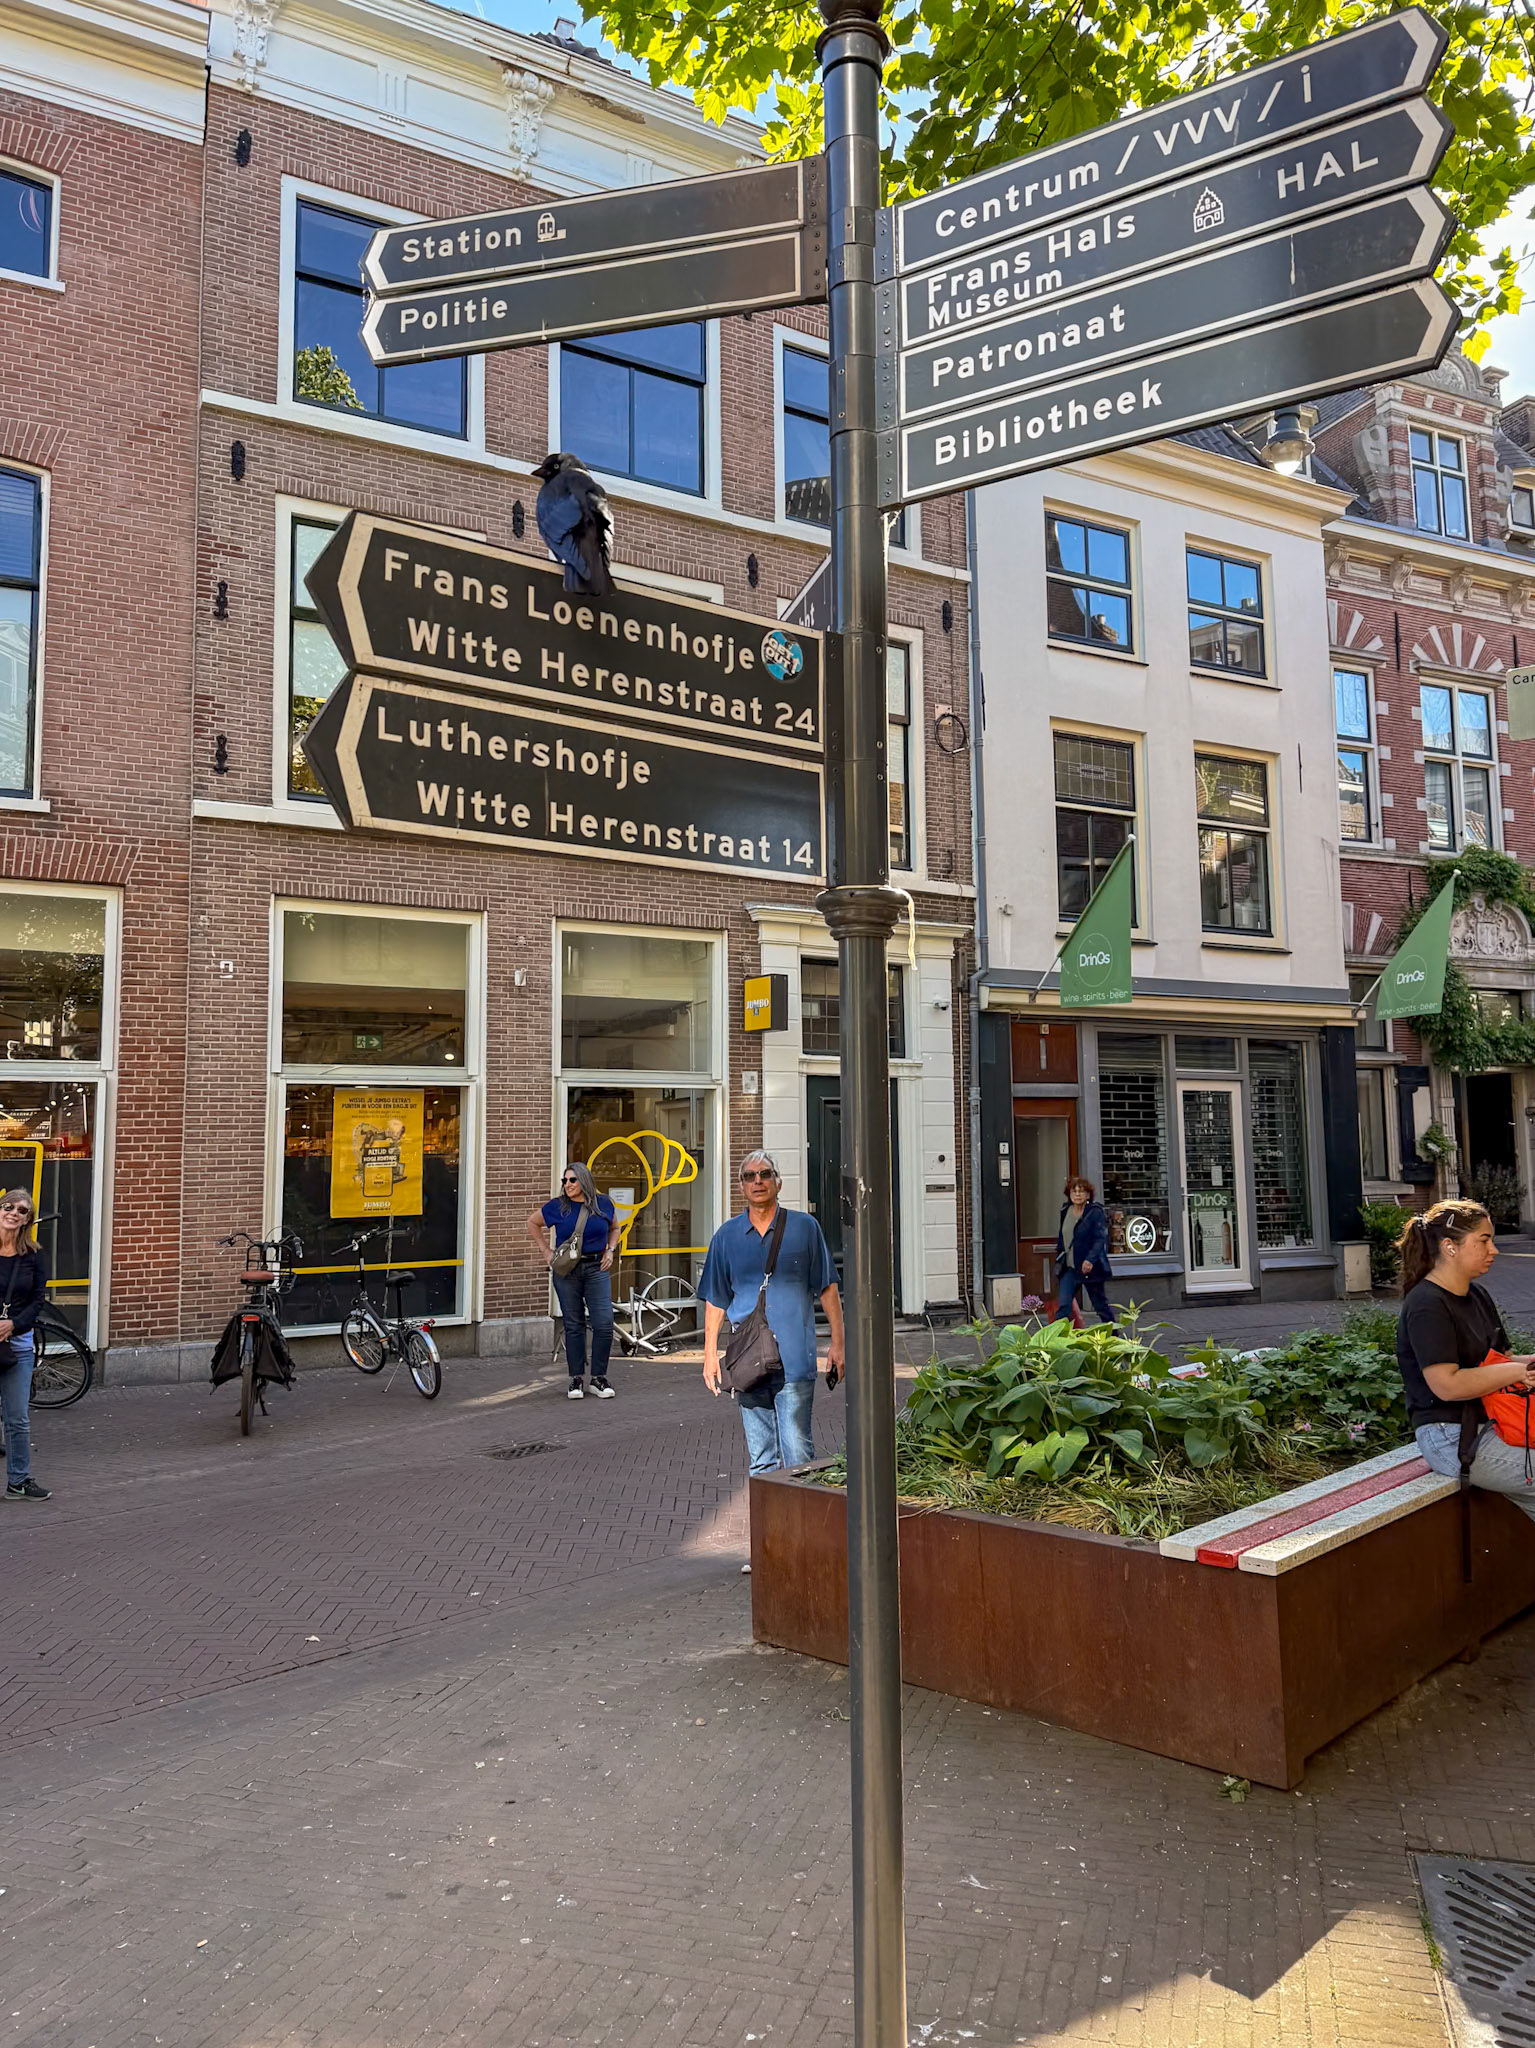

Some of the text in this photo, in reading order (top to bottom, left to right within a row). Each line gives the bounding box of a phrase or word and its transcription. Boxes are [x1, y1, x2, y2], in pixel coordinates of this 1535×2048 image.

[935, 160, 1100, 238] Centrum
[1153, 98, 1241, 157] VVV
[1301, 65, 1312, 103] i
[1277, 140, 1379, 200] HAL
[401, 223, 522, 264] Station
[928, 211, 1136, 305] Frans Hals
[400, 297, 508, 333] Politie
[928, 268, 1063, 331] Museum
[932, 303, 1126, 387] Patronaat
[935, 377, 1163, 467] Bibliotheek
[384, 548, 755, 675] Frans Loenenhofje
[407, 617, 816, 736] Witte Herenstraat 24
[768, 637, 794, 661] GET
[377, 706, 651, 790] Luthershofje
[417, 780, 814, 869] Witte Herenstraat 14
[1080, 951, 1110, 967] DrinQs
[1397, 970, 1425, 985] DrinQs
[746, 998, 770, 1010] JUMBO
[1064, 990, 1128, 1003] wine spirits beer
[1194, 1193, 1228, 1206] DrinQs
[1162, 1230, 1172, 1251] 7
